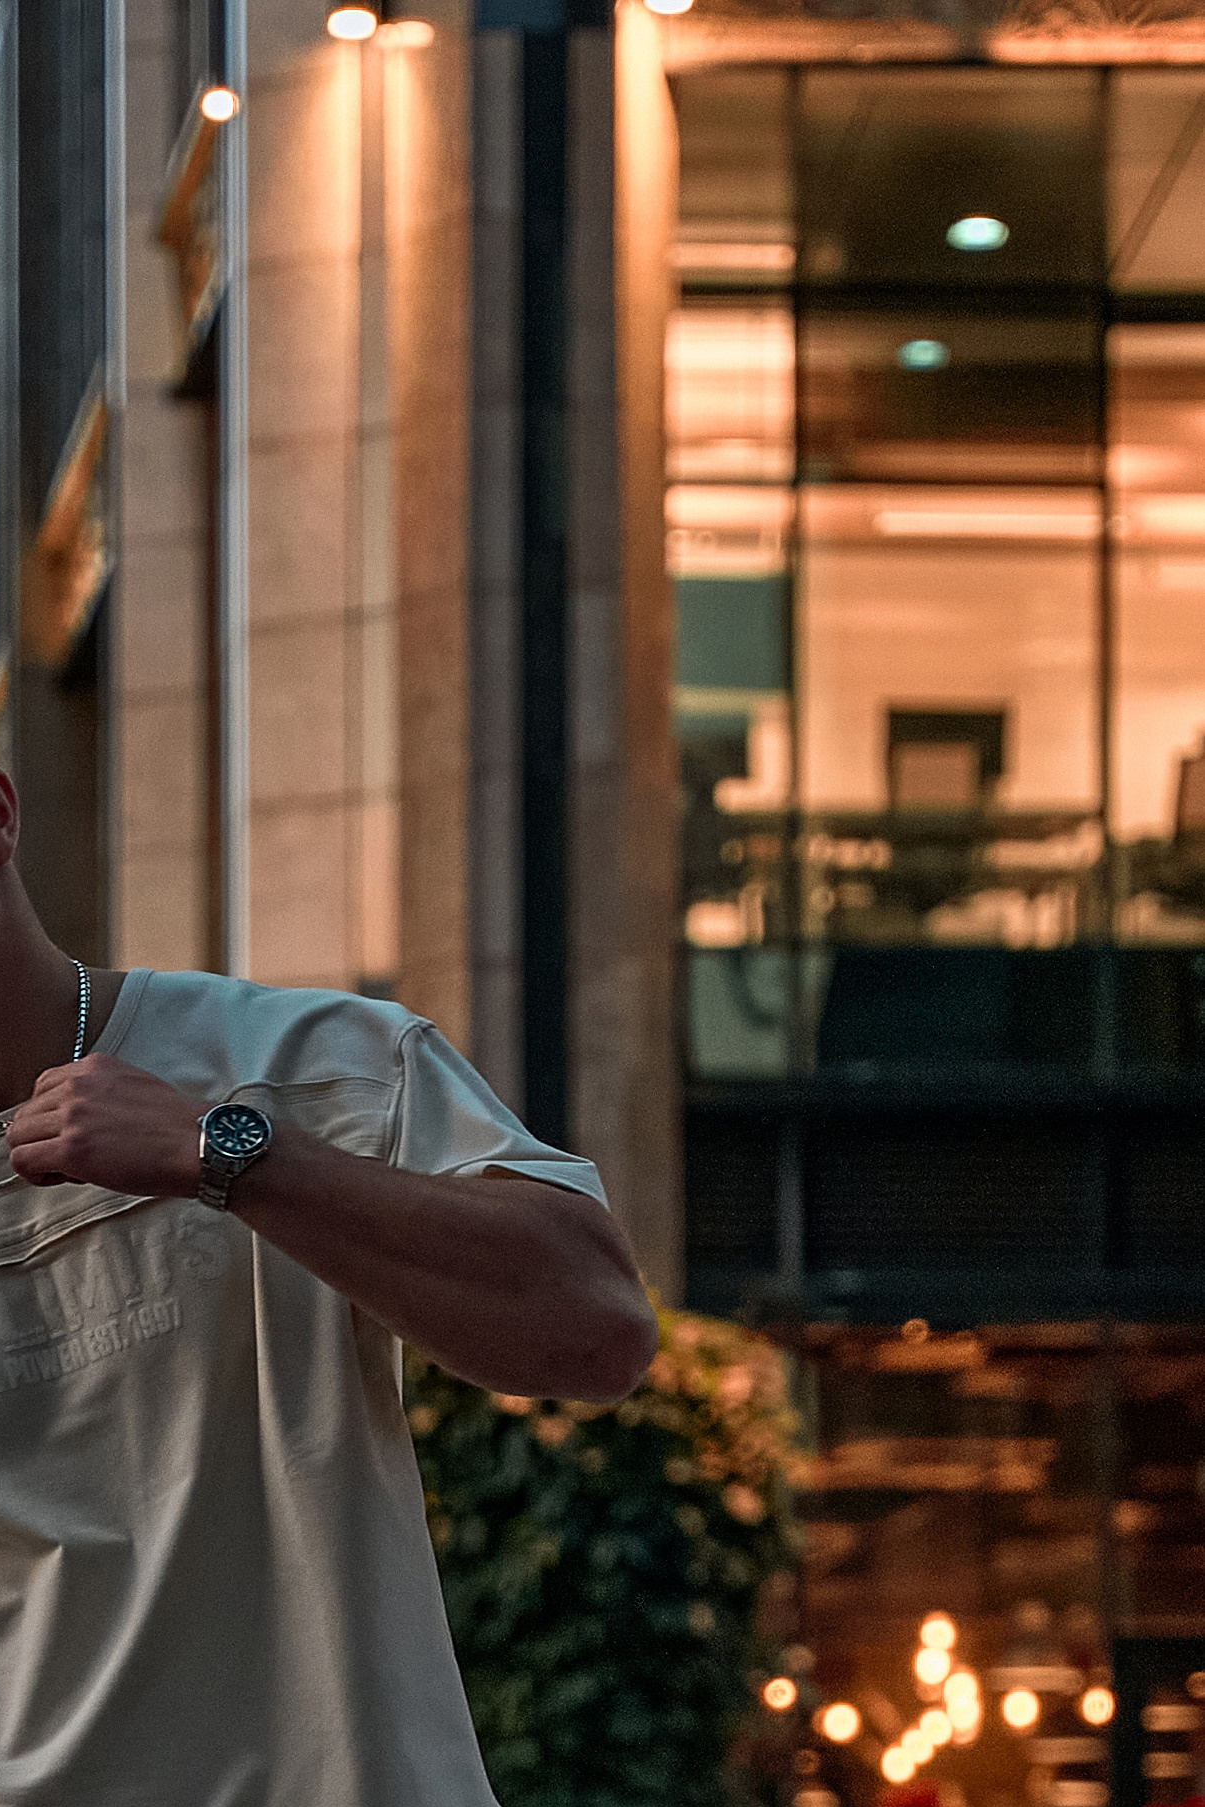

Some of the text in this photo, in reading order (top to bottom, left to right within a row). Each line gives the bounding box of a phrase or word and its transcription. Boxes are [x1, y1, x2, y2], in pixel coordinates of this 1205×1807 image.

[3, 1337, 86, 1389] POWER
[84, 1319, 130, 1364] EST.
[128, 1297, 185, 1343] 1997
